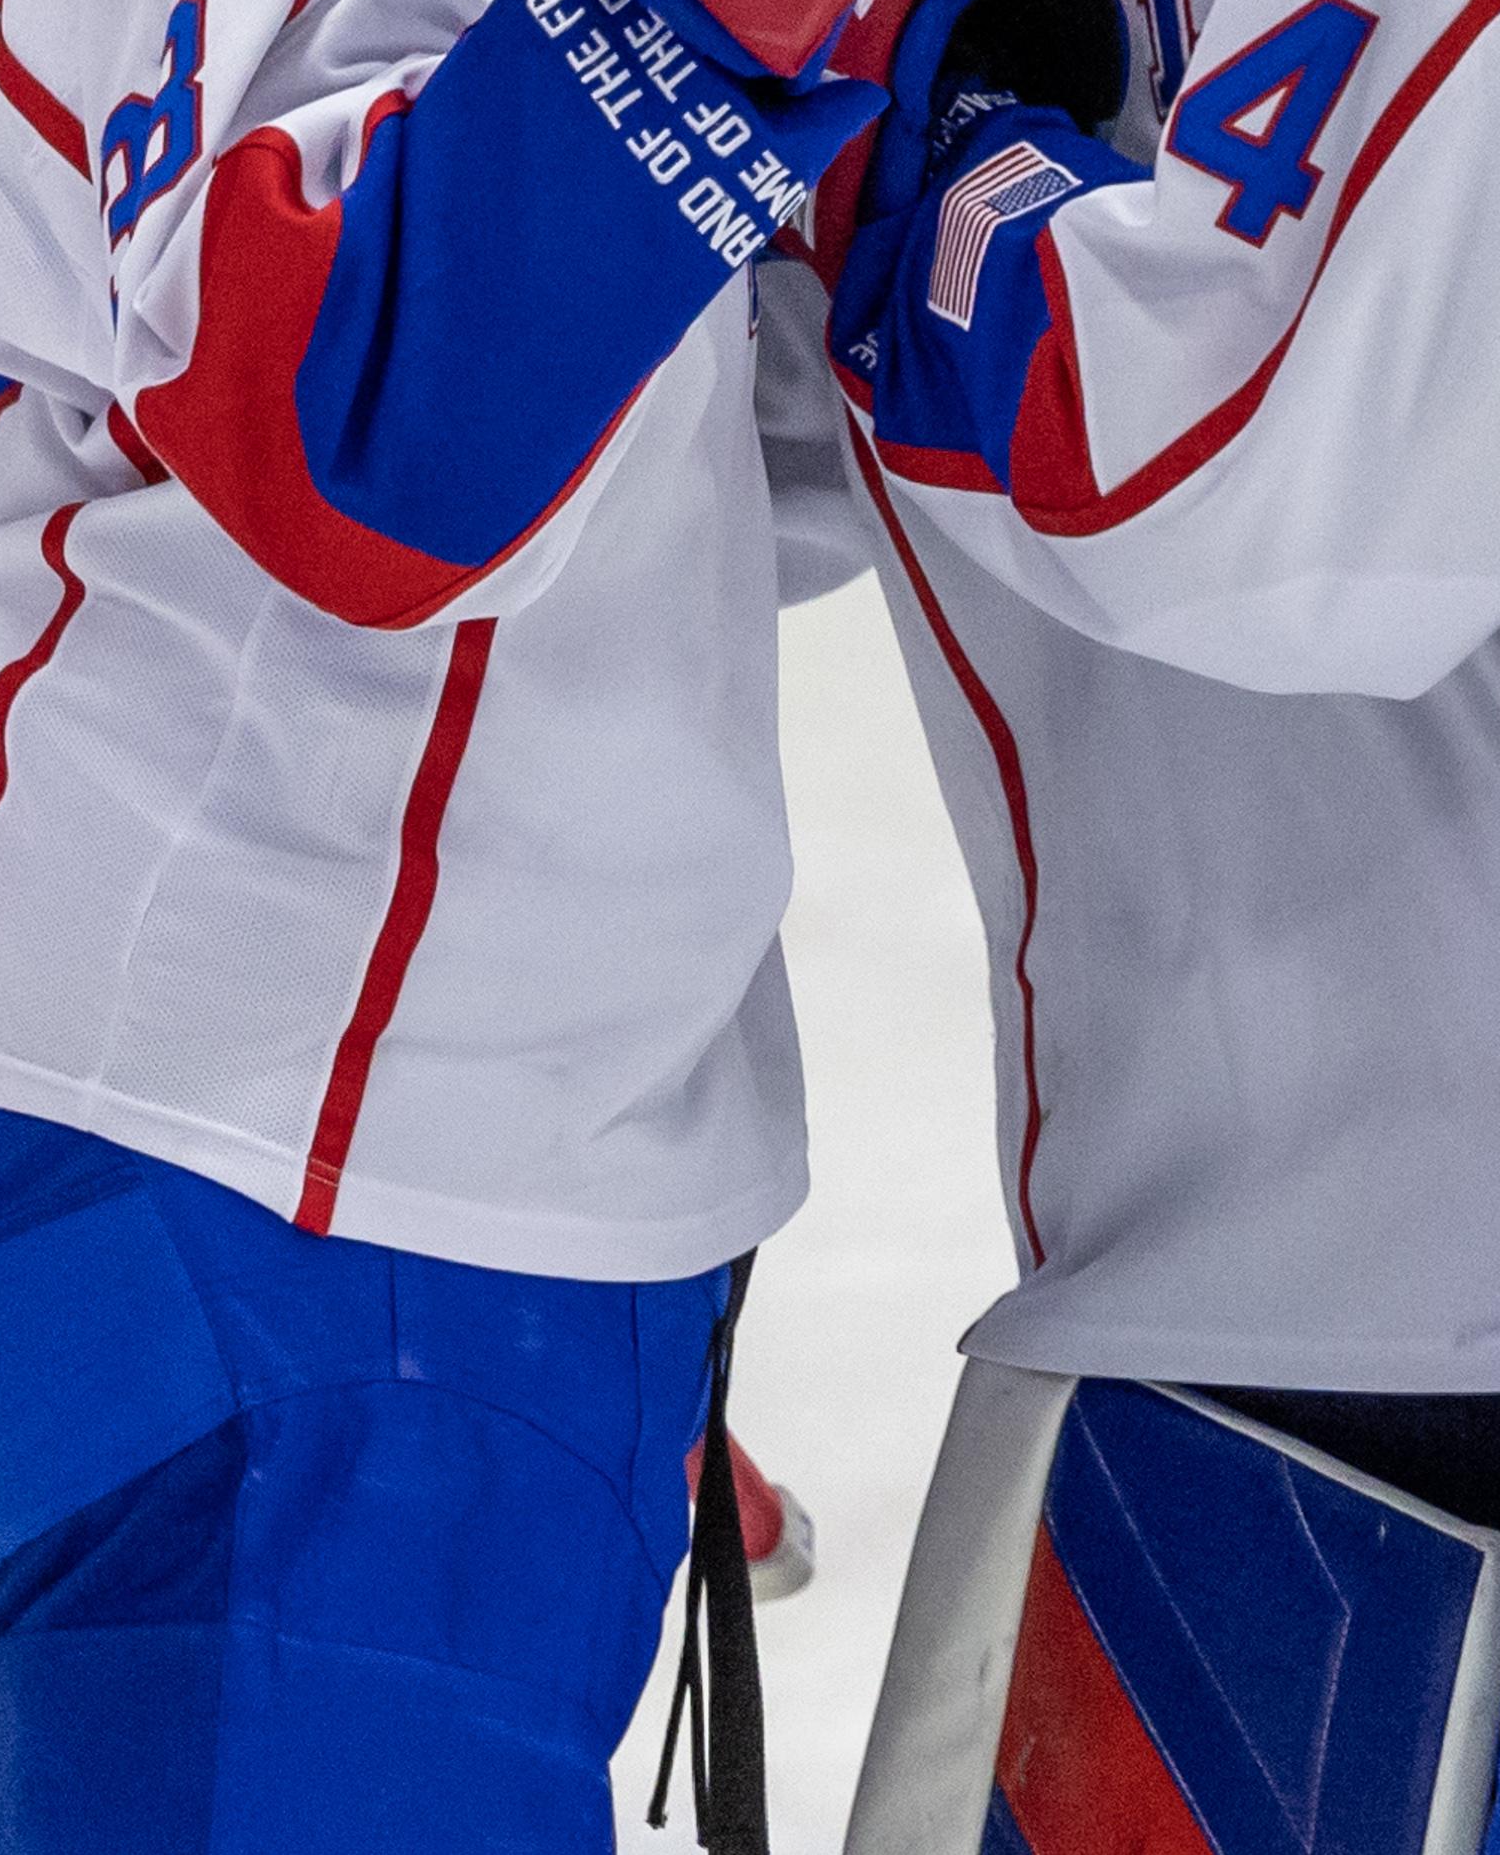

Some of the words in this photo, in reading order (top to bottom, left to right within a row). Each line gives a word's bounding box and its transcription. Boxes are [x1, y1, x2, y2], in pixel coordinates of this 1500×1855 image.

[565, 29, 644, 131] THE
[625, 127, 693, 186] OF
[677, 176, 768, 269] AND
[623, 6, 699, 105] THE
[682, 101, 753, 159] OF
[737, 148, 808, 228] OME
